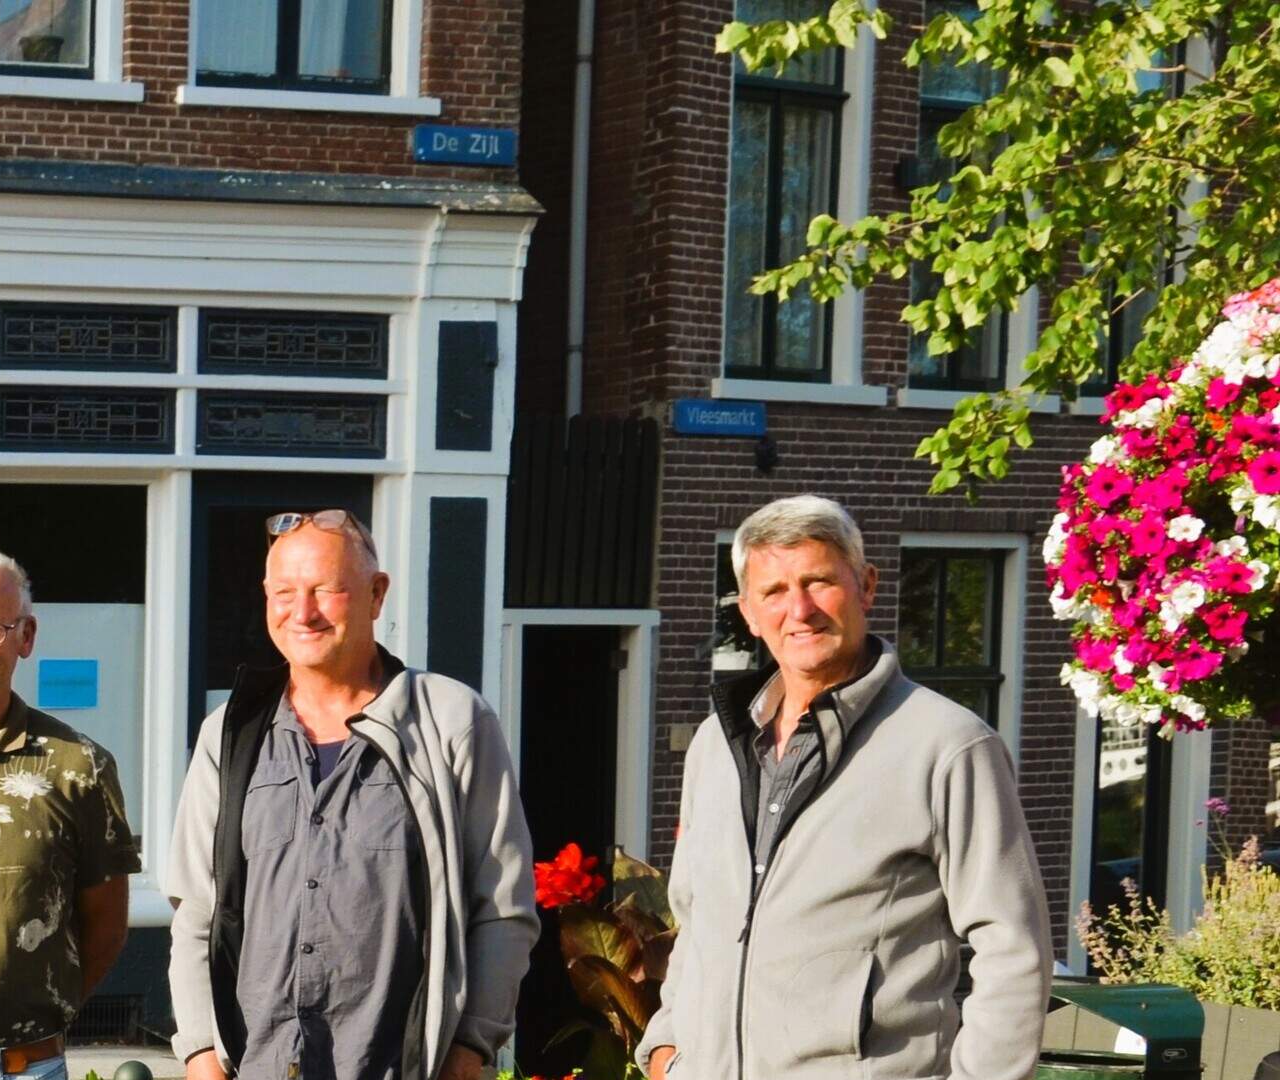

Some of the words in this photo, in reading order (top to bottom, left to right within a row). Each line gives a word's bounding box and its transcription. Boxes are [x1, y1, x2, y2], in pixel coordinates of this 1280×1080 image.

[432, 132, 458, 152] De
[469, 133, 499, 159] Zijl
[687, 407, 756, 426] Vleesmarkt
